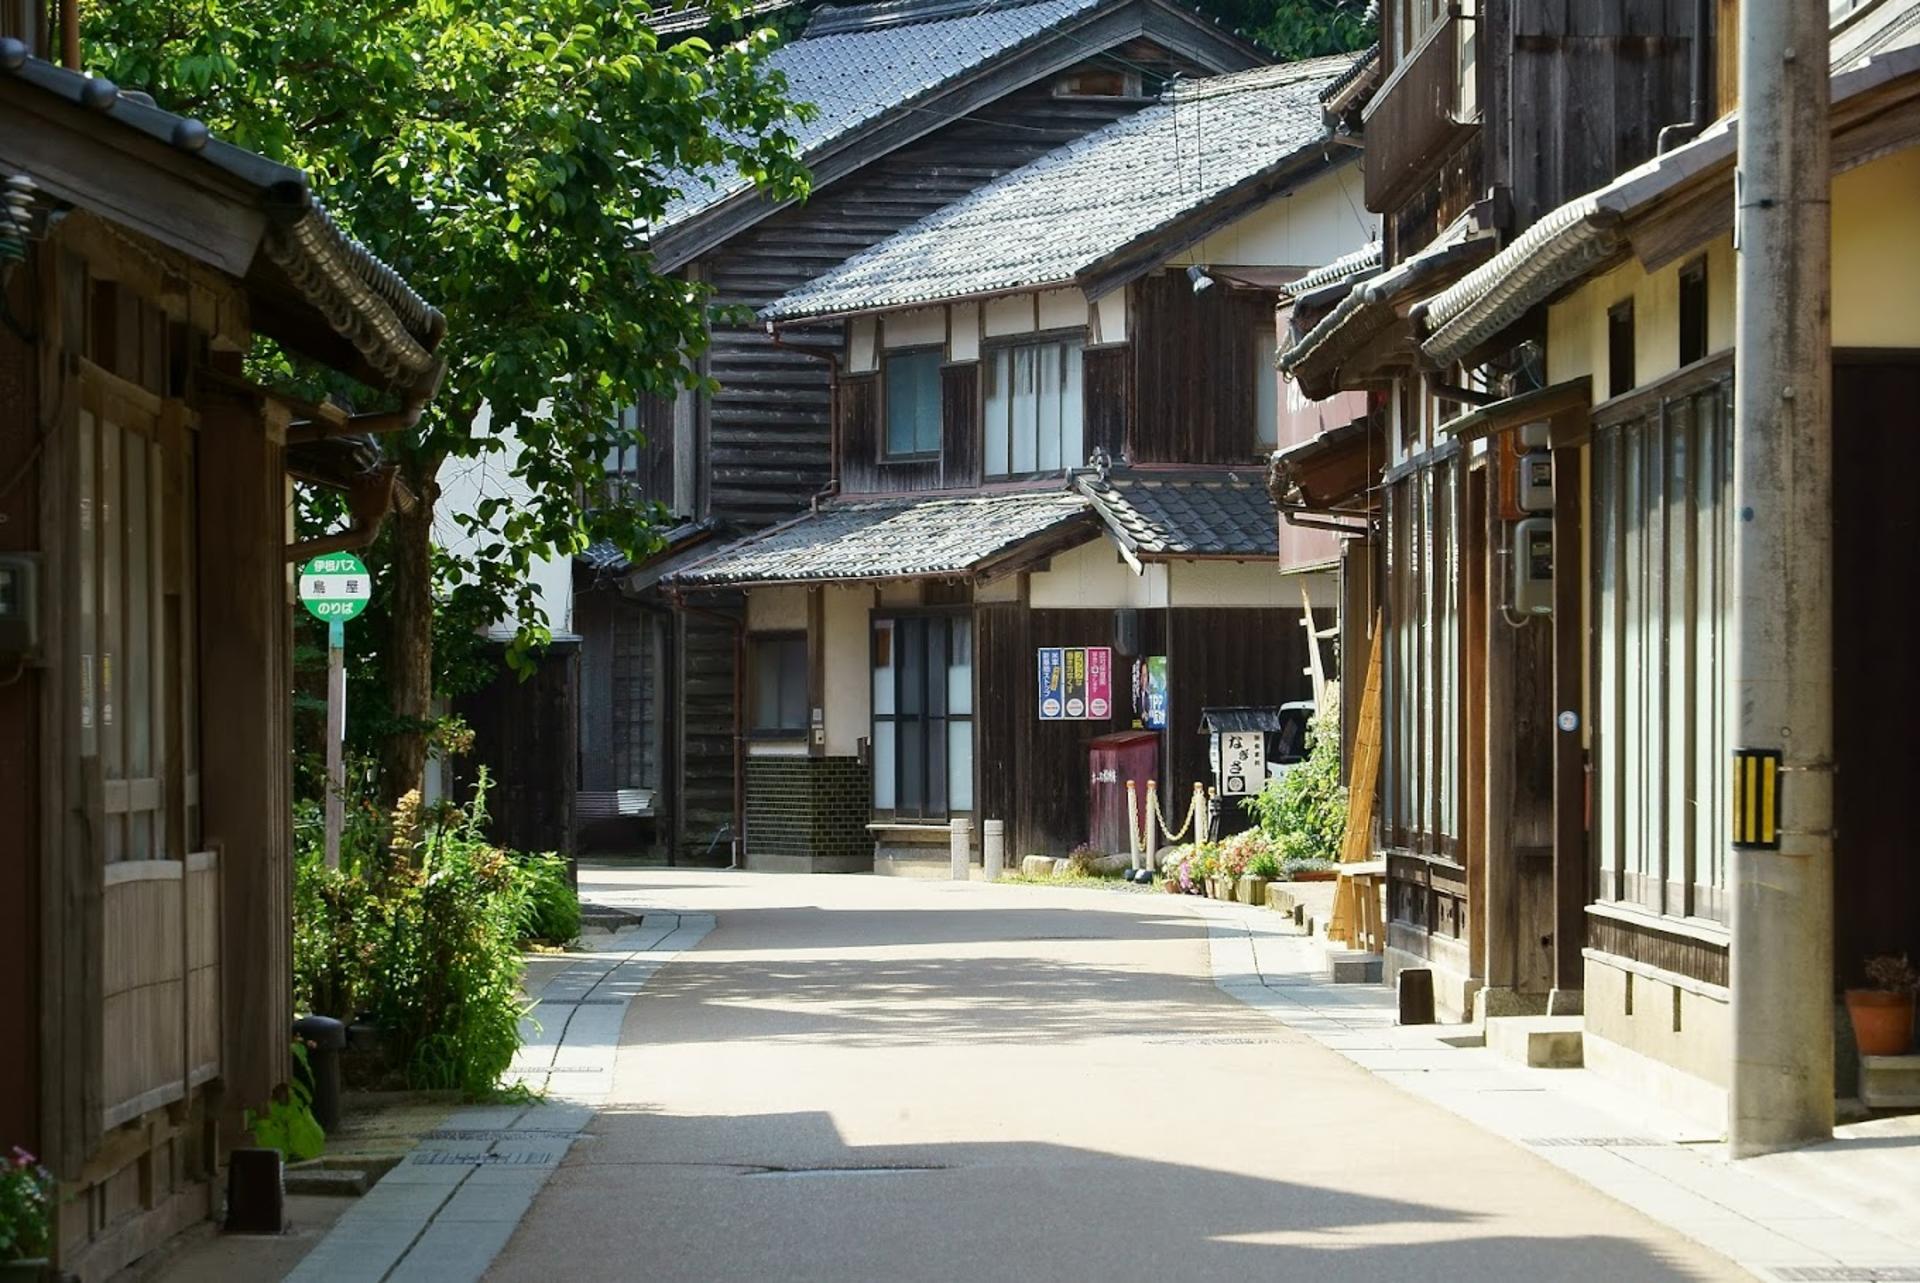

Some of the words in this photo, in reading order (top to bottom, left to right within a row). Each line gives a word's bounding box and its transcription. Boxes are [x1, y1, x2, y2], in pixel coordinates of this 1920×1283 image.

[314, 560, 356, 572] 伊根バス
[318, 602, 354, 614] のりば
[1229, 735, 1250, 774] なぎさ
